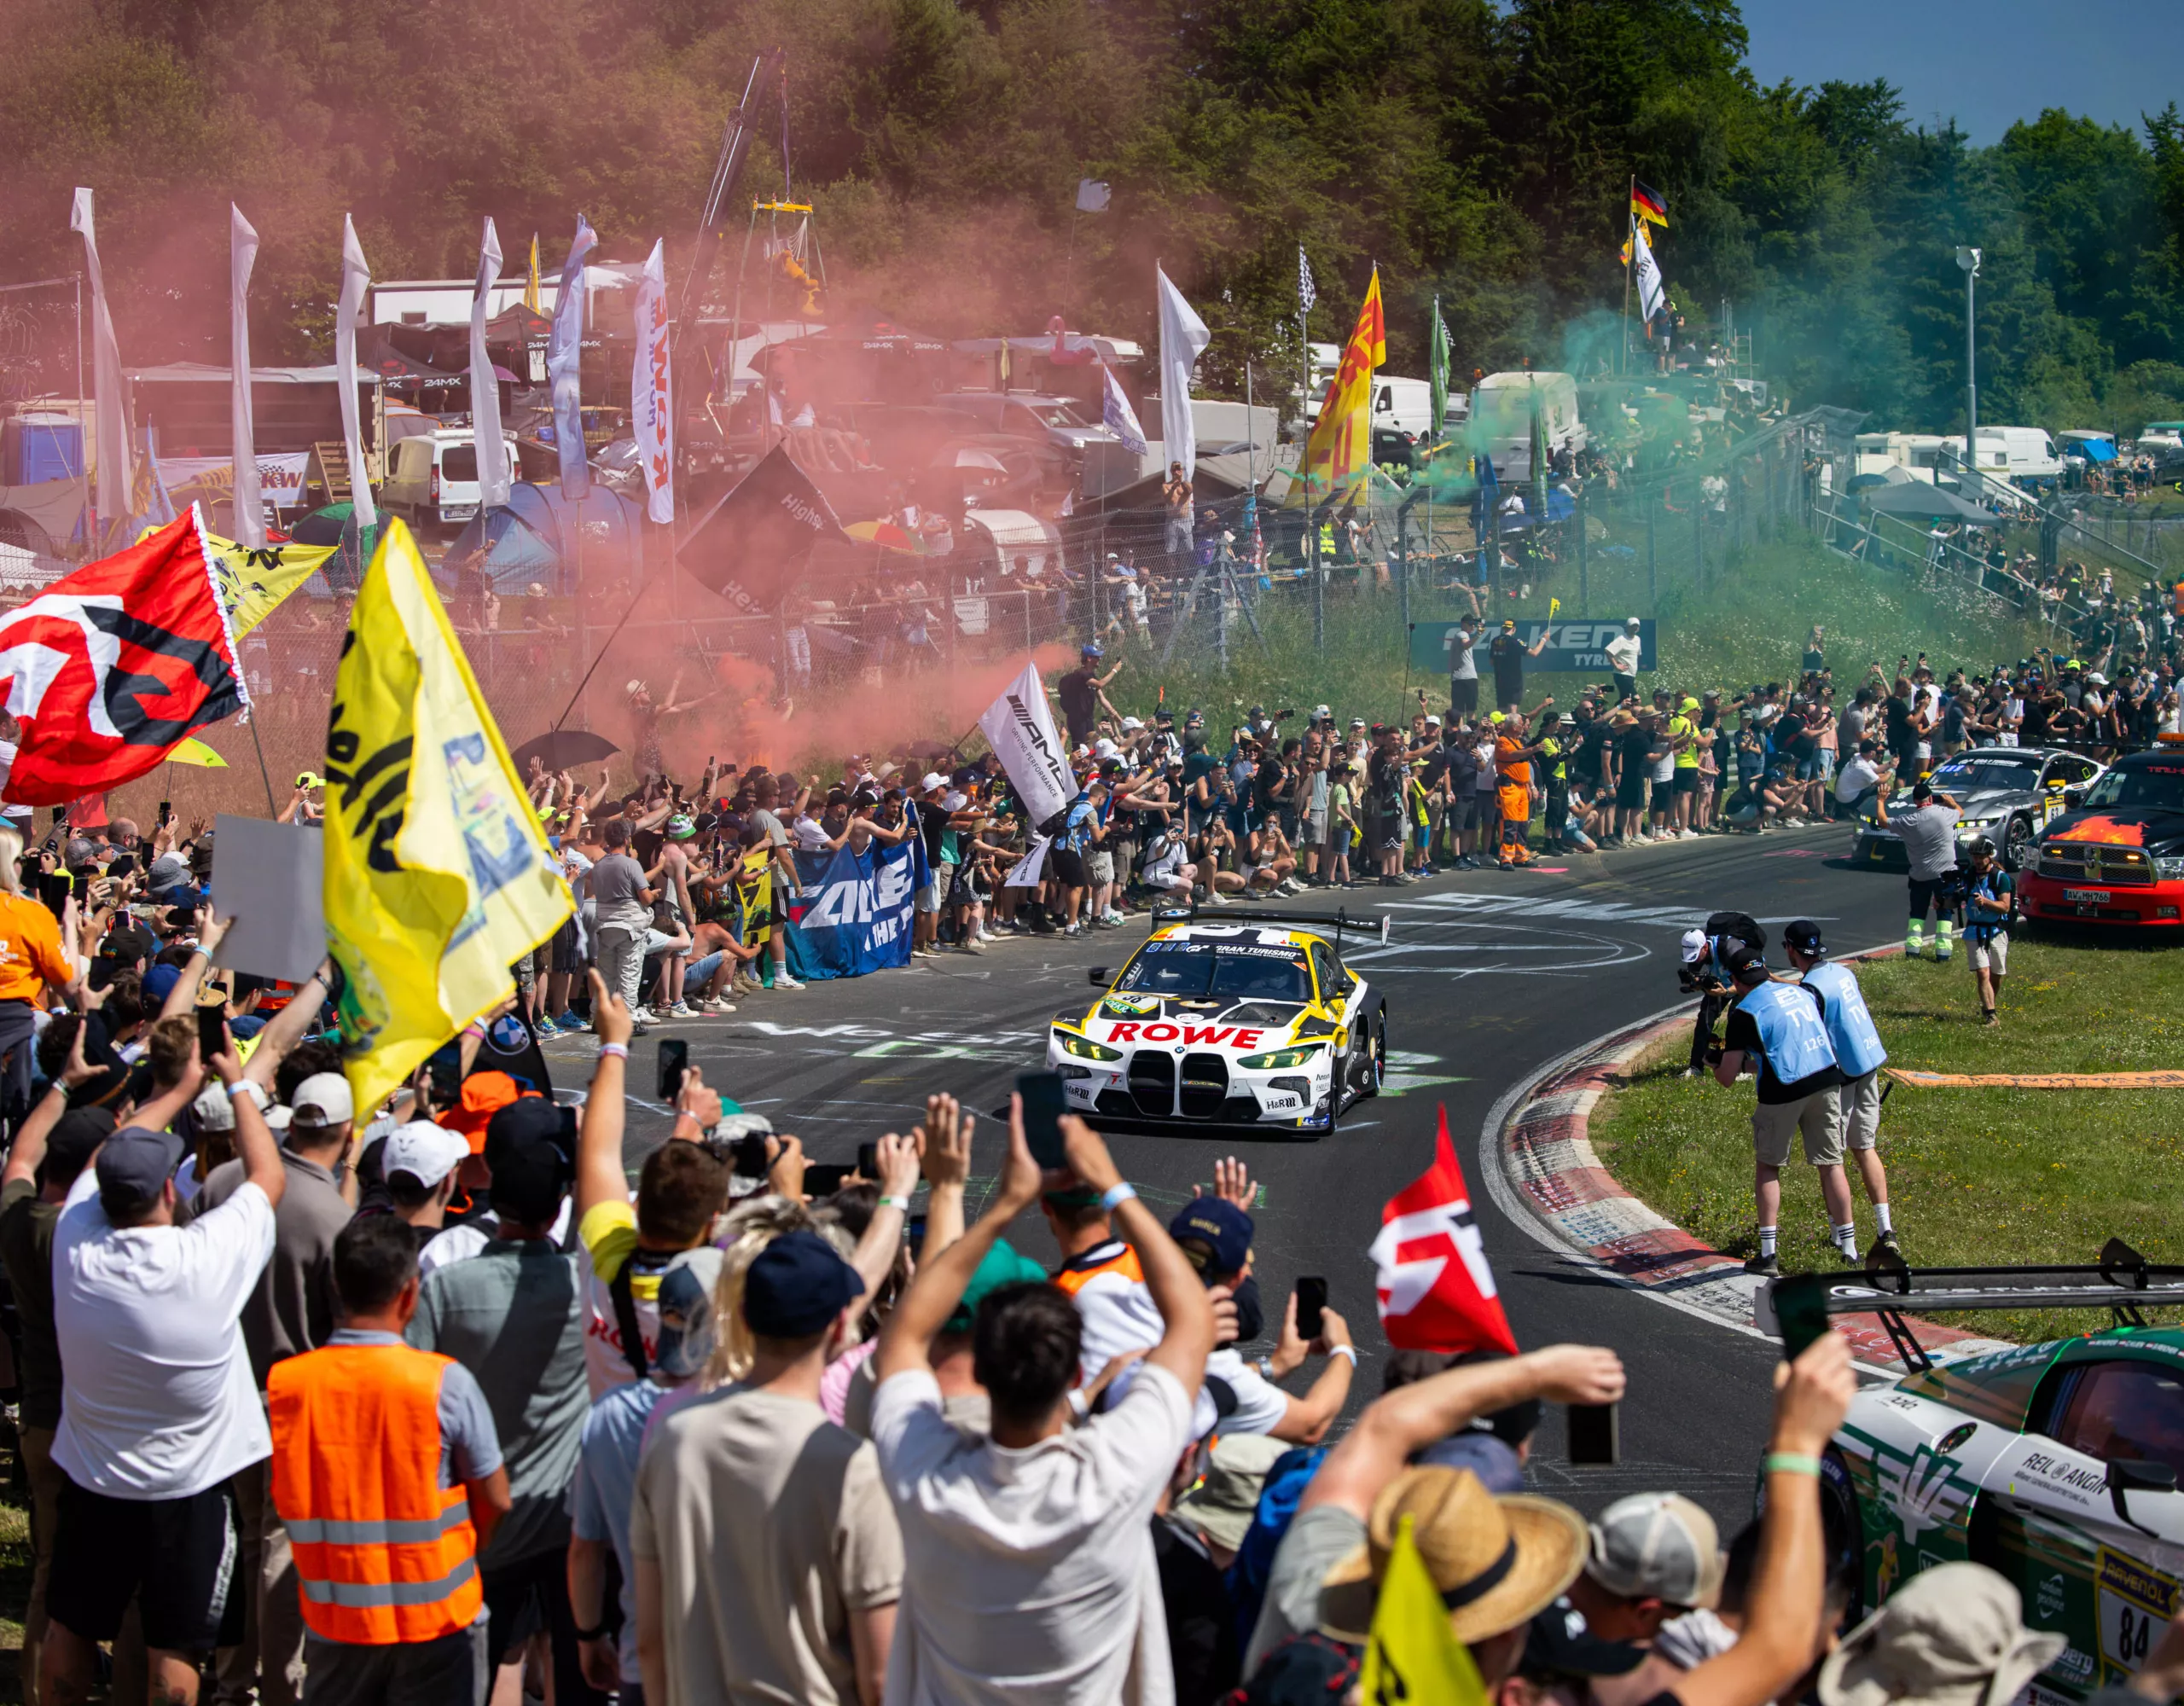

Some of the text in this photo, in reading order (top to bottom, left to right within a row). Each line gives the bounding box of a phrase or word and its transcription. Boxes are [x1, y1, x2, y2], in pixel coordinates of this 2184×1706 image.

[425, 377, 462, 387] 24MX
[261, 473, 303, 489] KW
[1011, 727, 1059, 798] DRIVING PERFORMANCE
[1248, 948, 1298, 958] TURISMO
[1786, 1004, 1815, 1028] TV
[1849, 1001, 1867, 1024] TV
[1107, 1023, 1264, 1050] ROWE
[1804, 1037, 1826, 1052] 126
[1863, 1036, 1879, 1050] 266
[2023, 1453, 2056, 1475] REIL
[2120, 1605, 2150, 1662] 84
